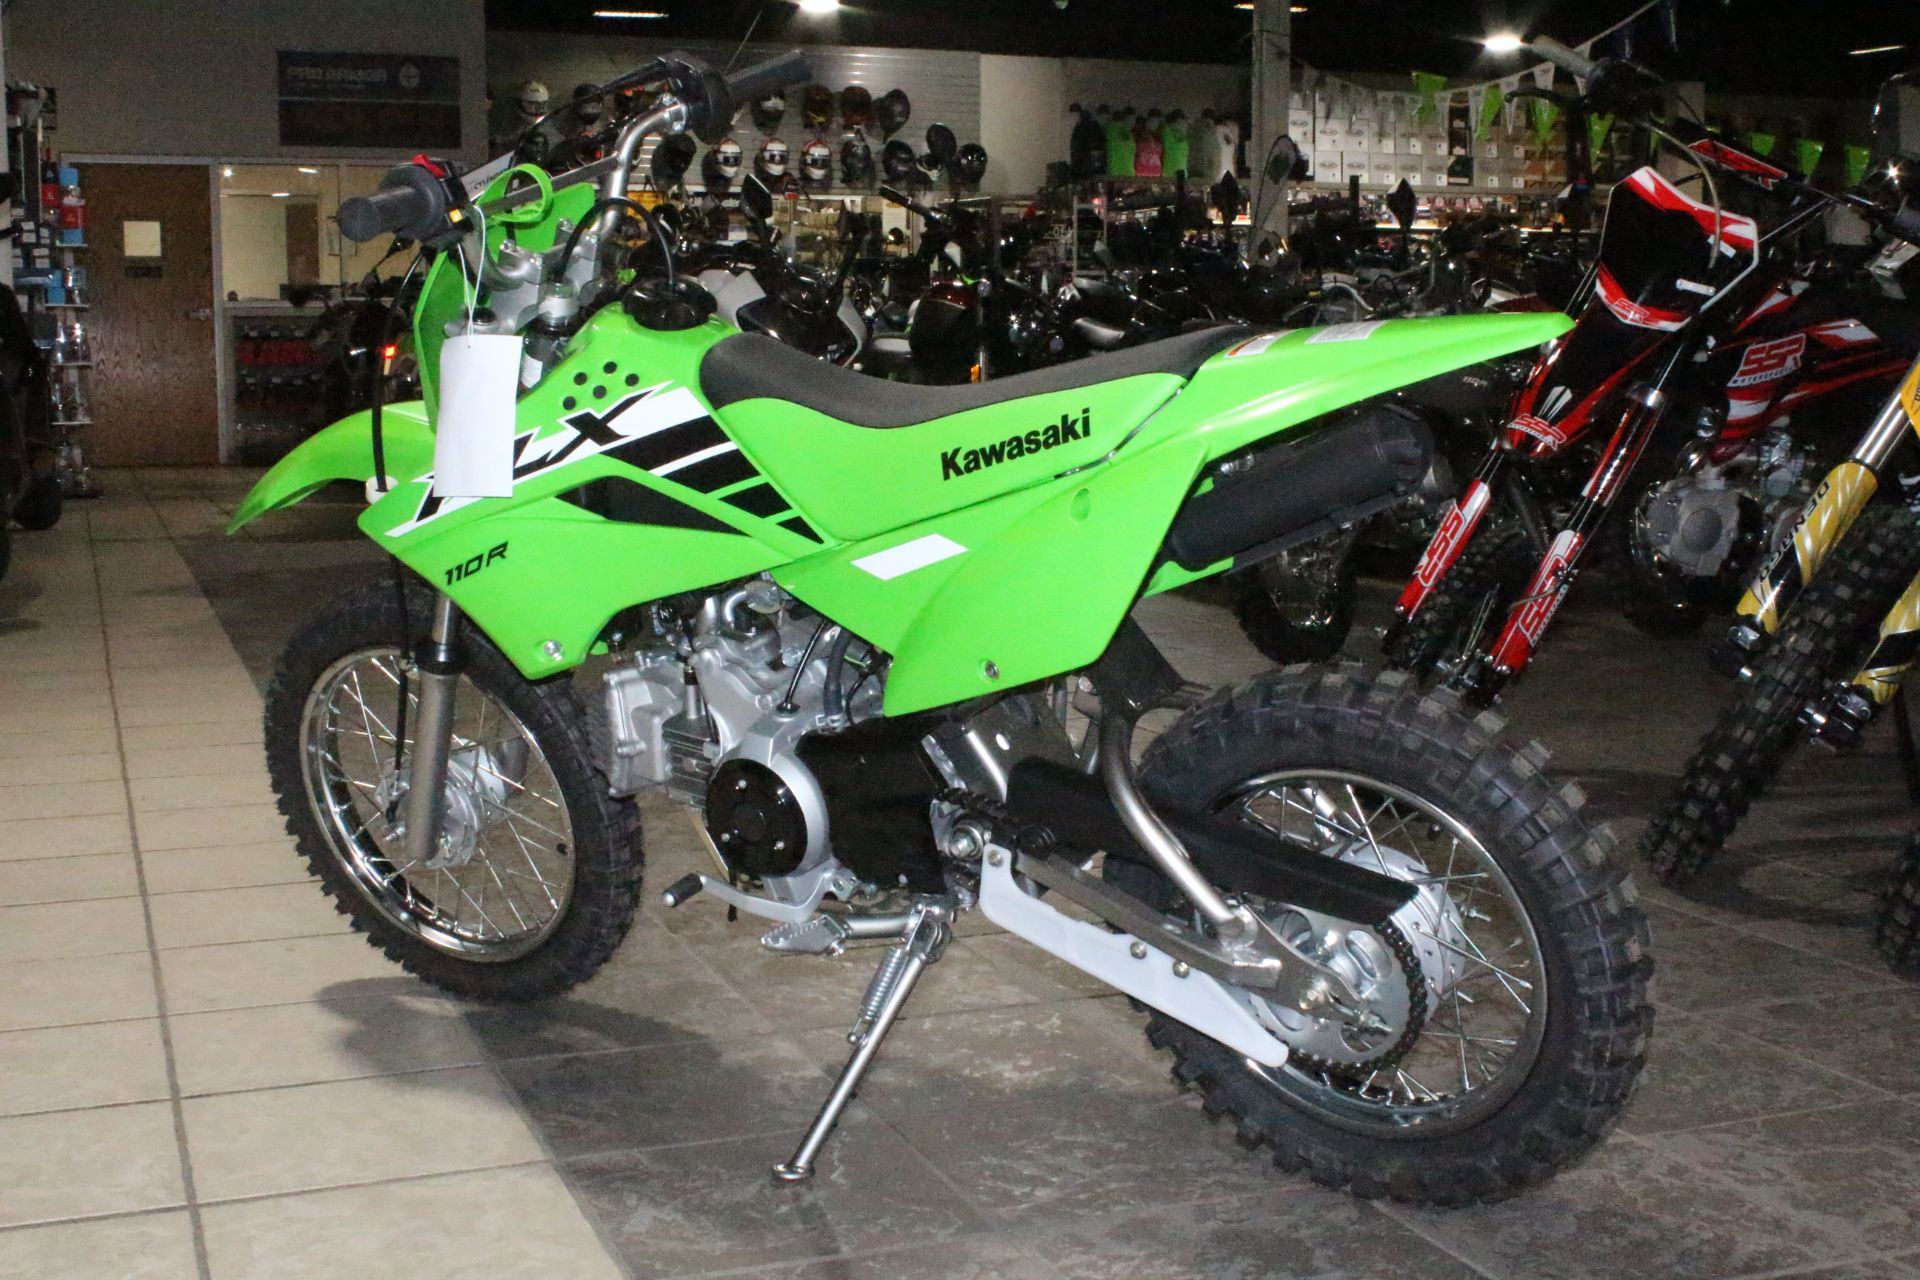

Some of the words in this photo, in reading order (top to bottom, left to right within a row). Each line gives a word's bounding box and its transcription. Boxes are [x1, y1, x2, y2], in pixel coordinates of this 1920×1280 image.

[1737, 332, 1807, 377] SSR
[941, 407, 1091, 481] Kawasaki
[1513, 412, 1568, 451] SSR
[1415, 502, 1467, 587] SSR
